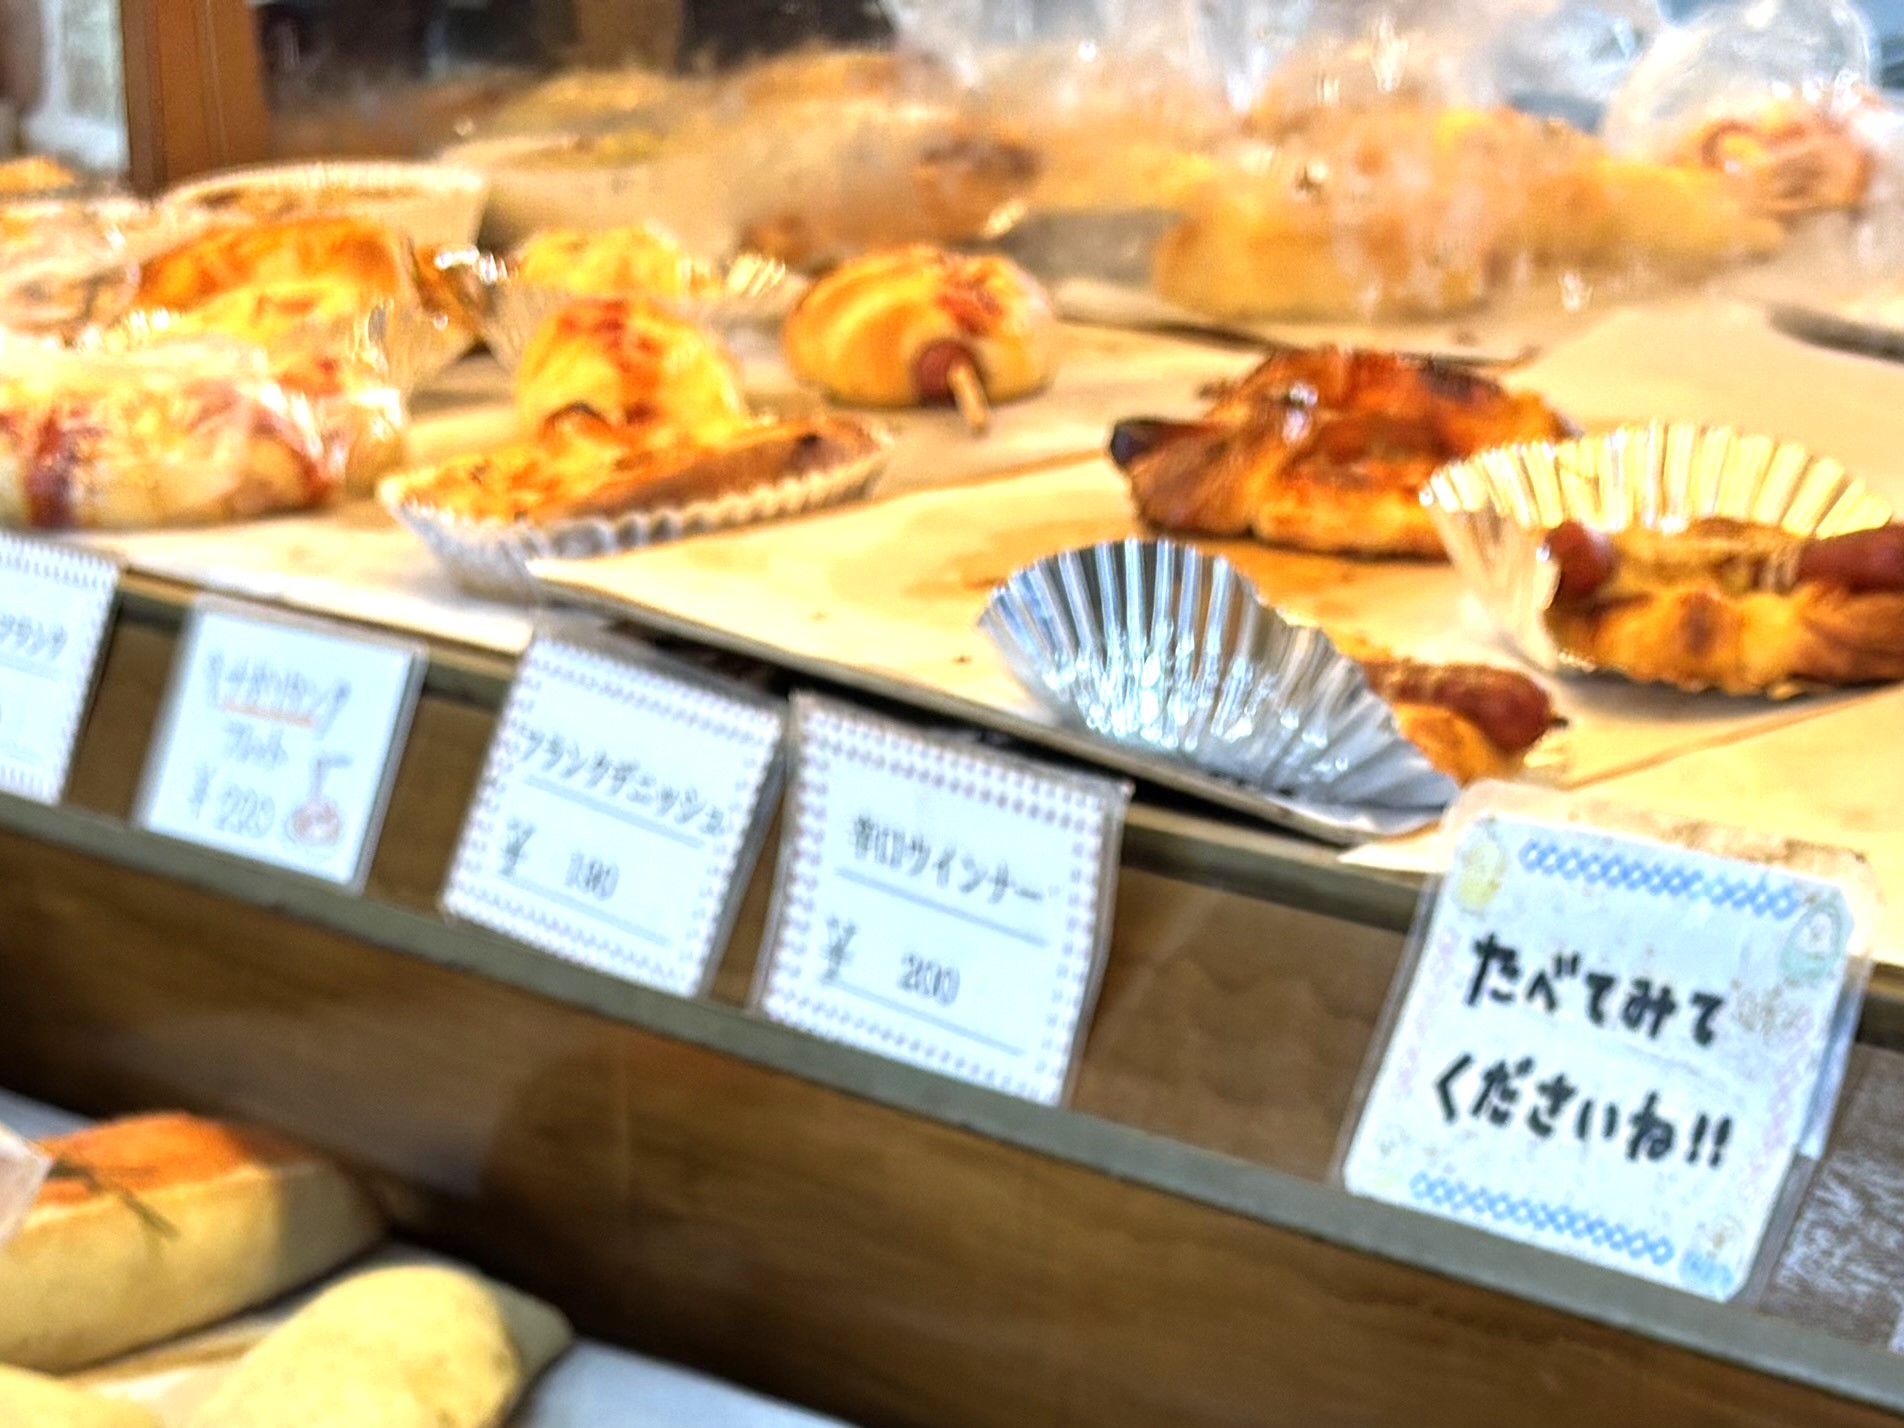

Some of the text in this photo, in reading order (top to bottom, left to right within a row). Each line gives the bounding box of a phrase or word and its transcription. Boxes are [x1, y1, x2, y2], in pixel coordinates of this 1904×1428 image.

[898, 952, 961, 1006] 200
[1466, 933, 1726, 1047] たべてみて
